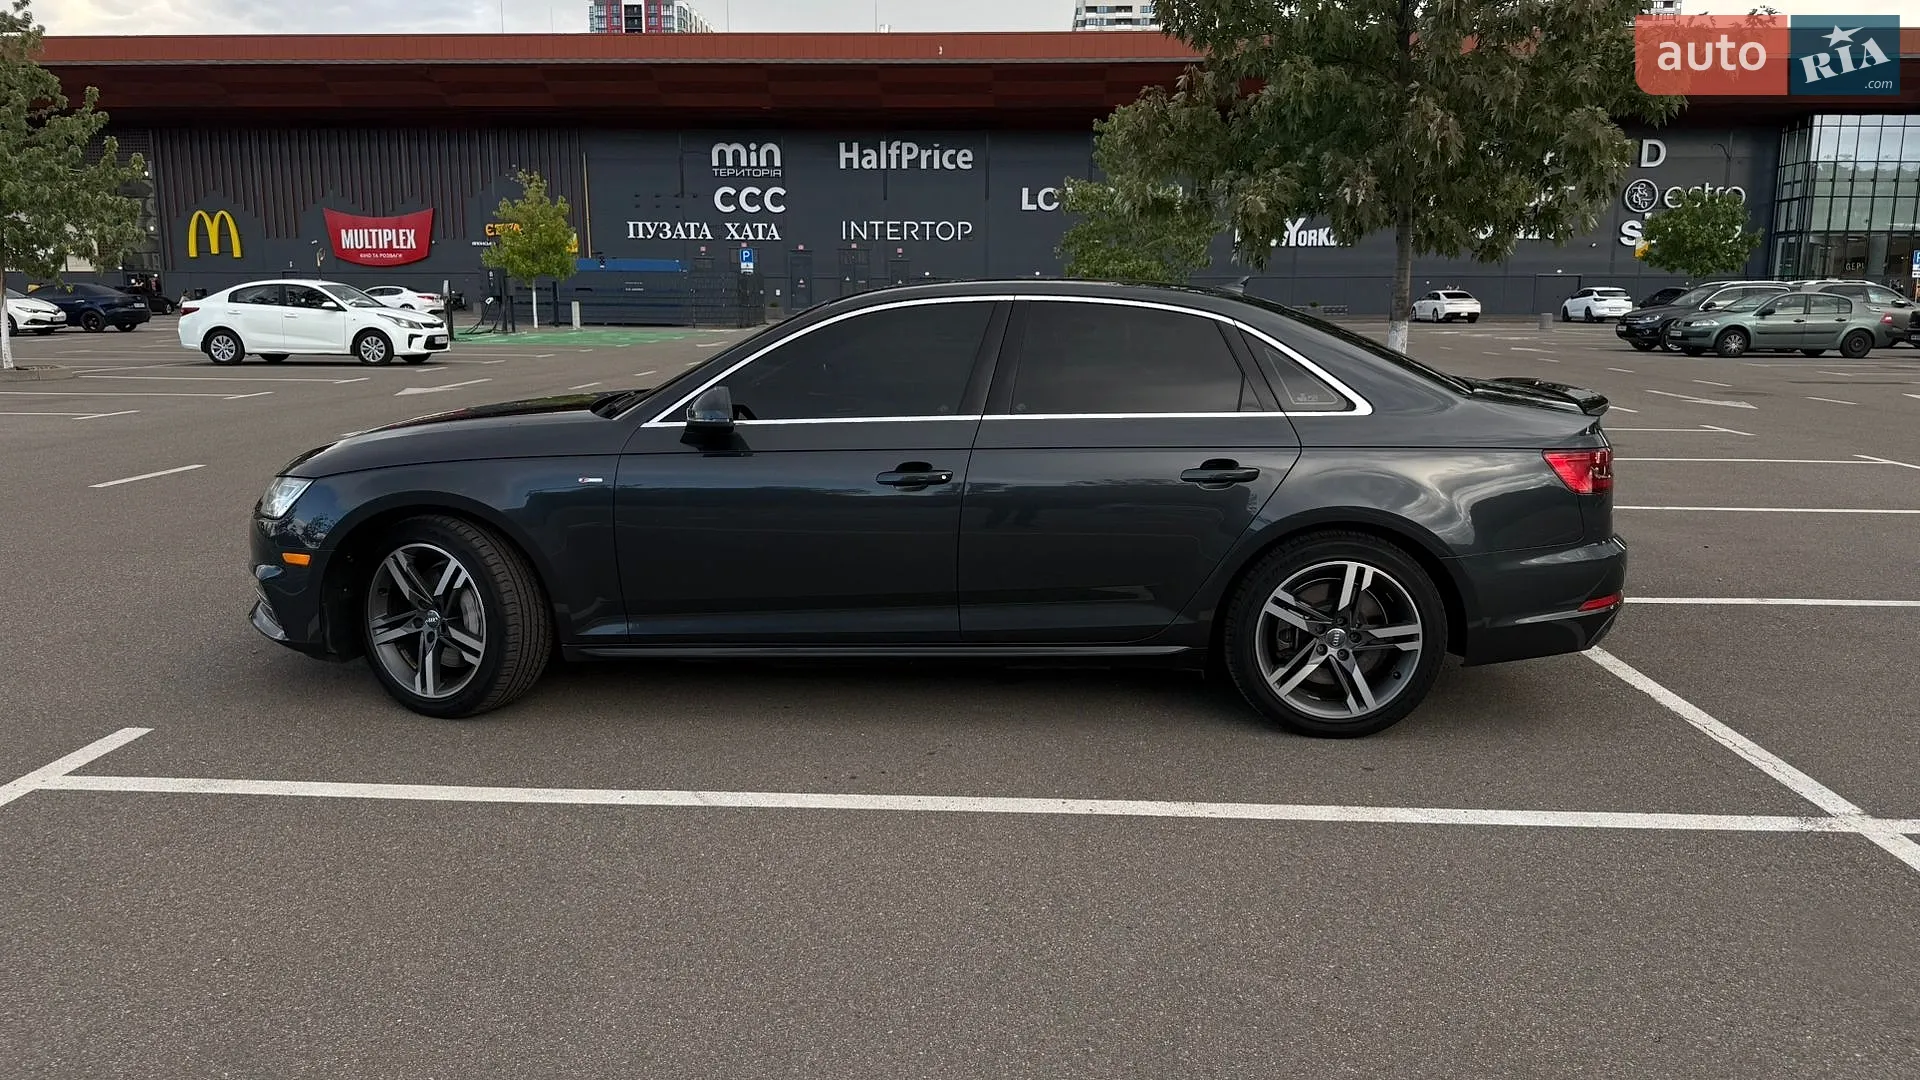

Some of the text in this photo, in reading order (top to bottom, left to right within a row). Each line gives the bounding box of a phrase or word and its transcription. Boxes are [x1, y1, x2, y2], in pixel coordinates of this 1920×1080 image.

[839, 141, 974, 170] HalfPrice
[713, 186, 787, 213] CCC
[341, 228, 417, 250] MULTIPLEX
[626, 221, 782, 241] ПУЗАТА ХАТА
[842, 220, 973, 241] INTERTOP
